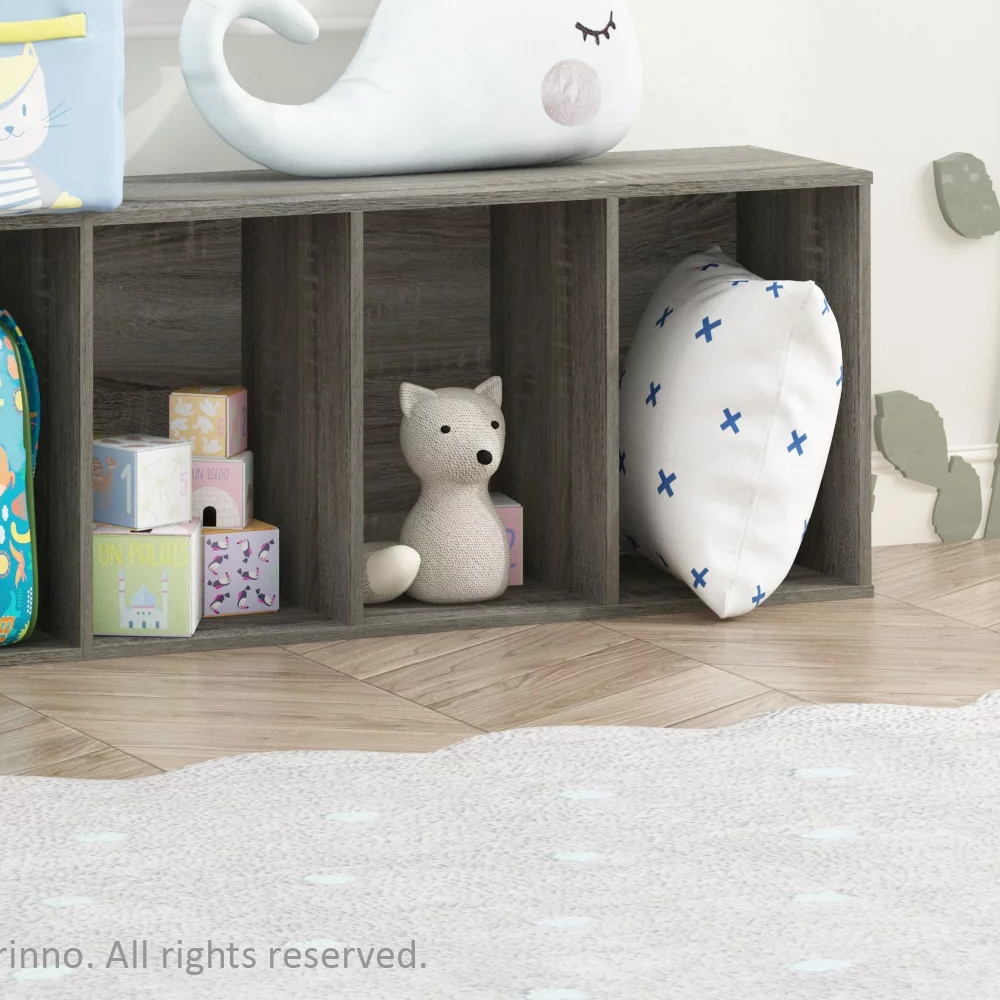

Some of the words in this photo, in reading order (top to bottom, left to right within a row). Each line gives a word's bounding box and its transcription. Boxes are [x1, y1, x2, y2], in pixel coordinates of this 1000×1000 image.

[179, 472, 188, 496] 5
[192, 468, 204, 480] UN
[207, 467, 230, 480] IGLOO
[120, 463, 132, 515] 1
[98, 542, 123, 566] UN
